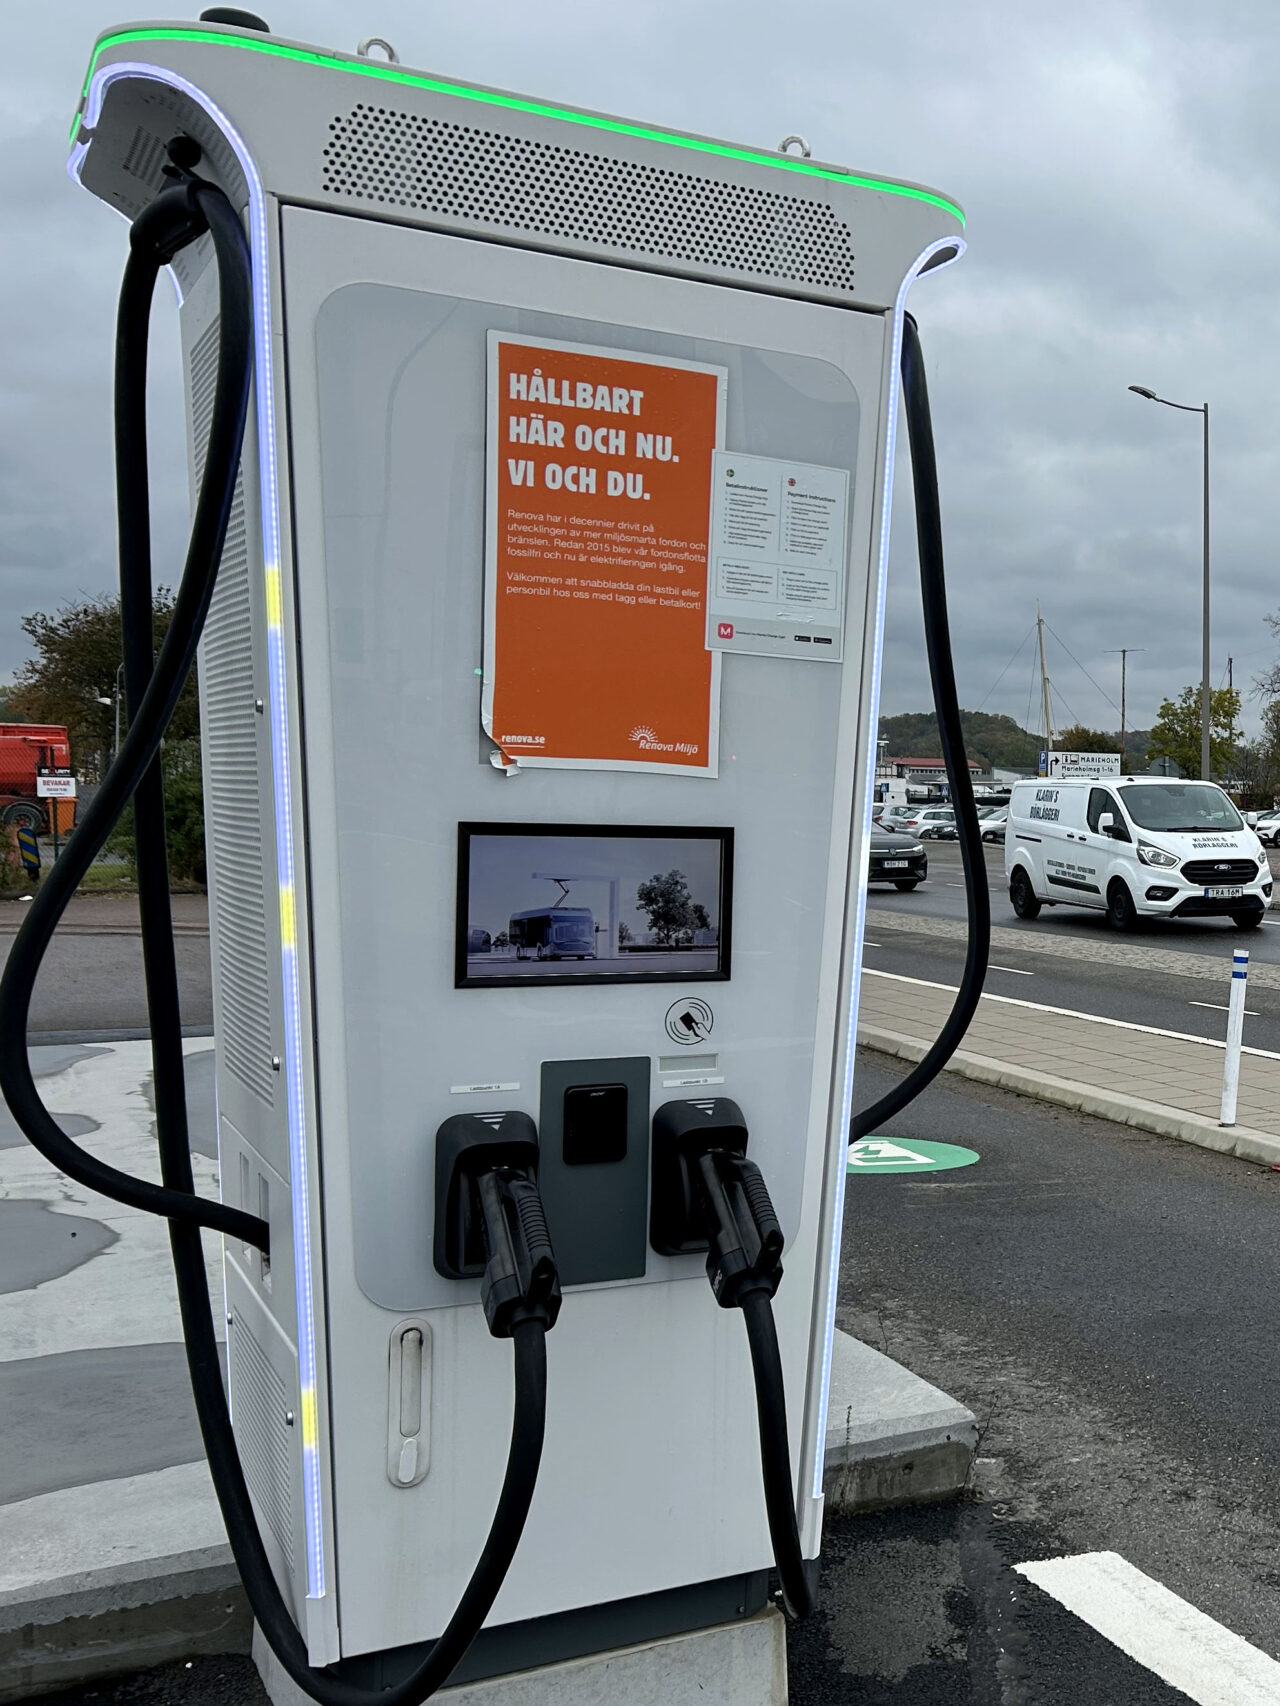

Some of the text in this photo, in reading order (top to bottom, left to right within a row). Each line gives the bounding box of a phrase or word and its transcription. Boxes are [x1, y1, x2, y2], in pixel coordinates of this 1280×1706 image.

[510, 368, 644, 416] HÅLLBART
[509, 413, 679, 463] HÄR OCH NU.
[508, 458, 650, 500] VI OCH DU.
[507, 509, 654, 533] Renova har i decennier drivit på
[507, 523, 567, 536] utvecklingen
[583, 530, 601, 539] mer
[604, 532, 656, 544] miljösmarta
[659, 537, 687, 548] fordon
[690, 542, 706, 550] och
[507, 535, 706, 563] bränslen. Redan 2015 blev vår fordonsflotta
[507, 547, 540, 557] fossilfri
[579, 554, 588, 562] är
[590, 556, 656, 569] elektrifieringen
[659, 561, 686, 573] igång.
[507, 572, 700, 597] Välkommen att snabbladda din lastbil eller
[506, 586, 550, 595] personbil
[553, 588, 571, 597] hos
[573, 591, 589, 599] oss
[615, 594, 636, 604] tagg
[638, 596, 656, 604] eller
[660, 598, 700, 609] betalkort!
[502, 735, 545, 744] renova.se
[639, 740, 699, 756] Renova Miljö
[1062, 765, 1100, 773] Marieholmsg
